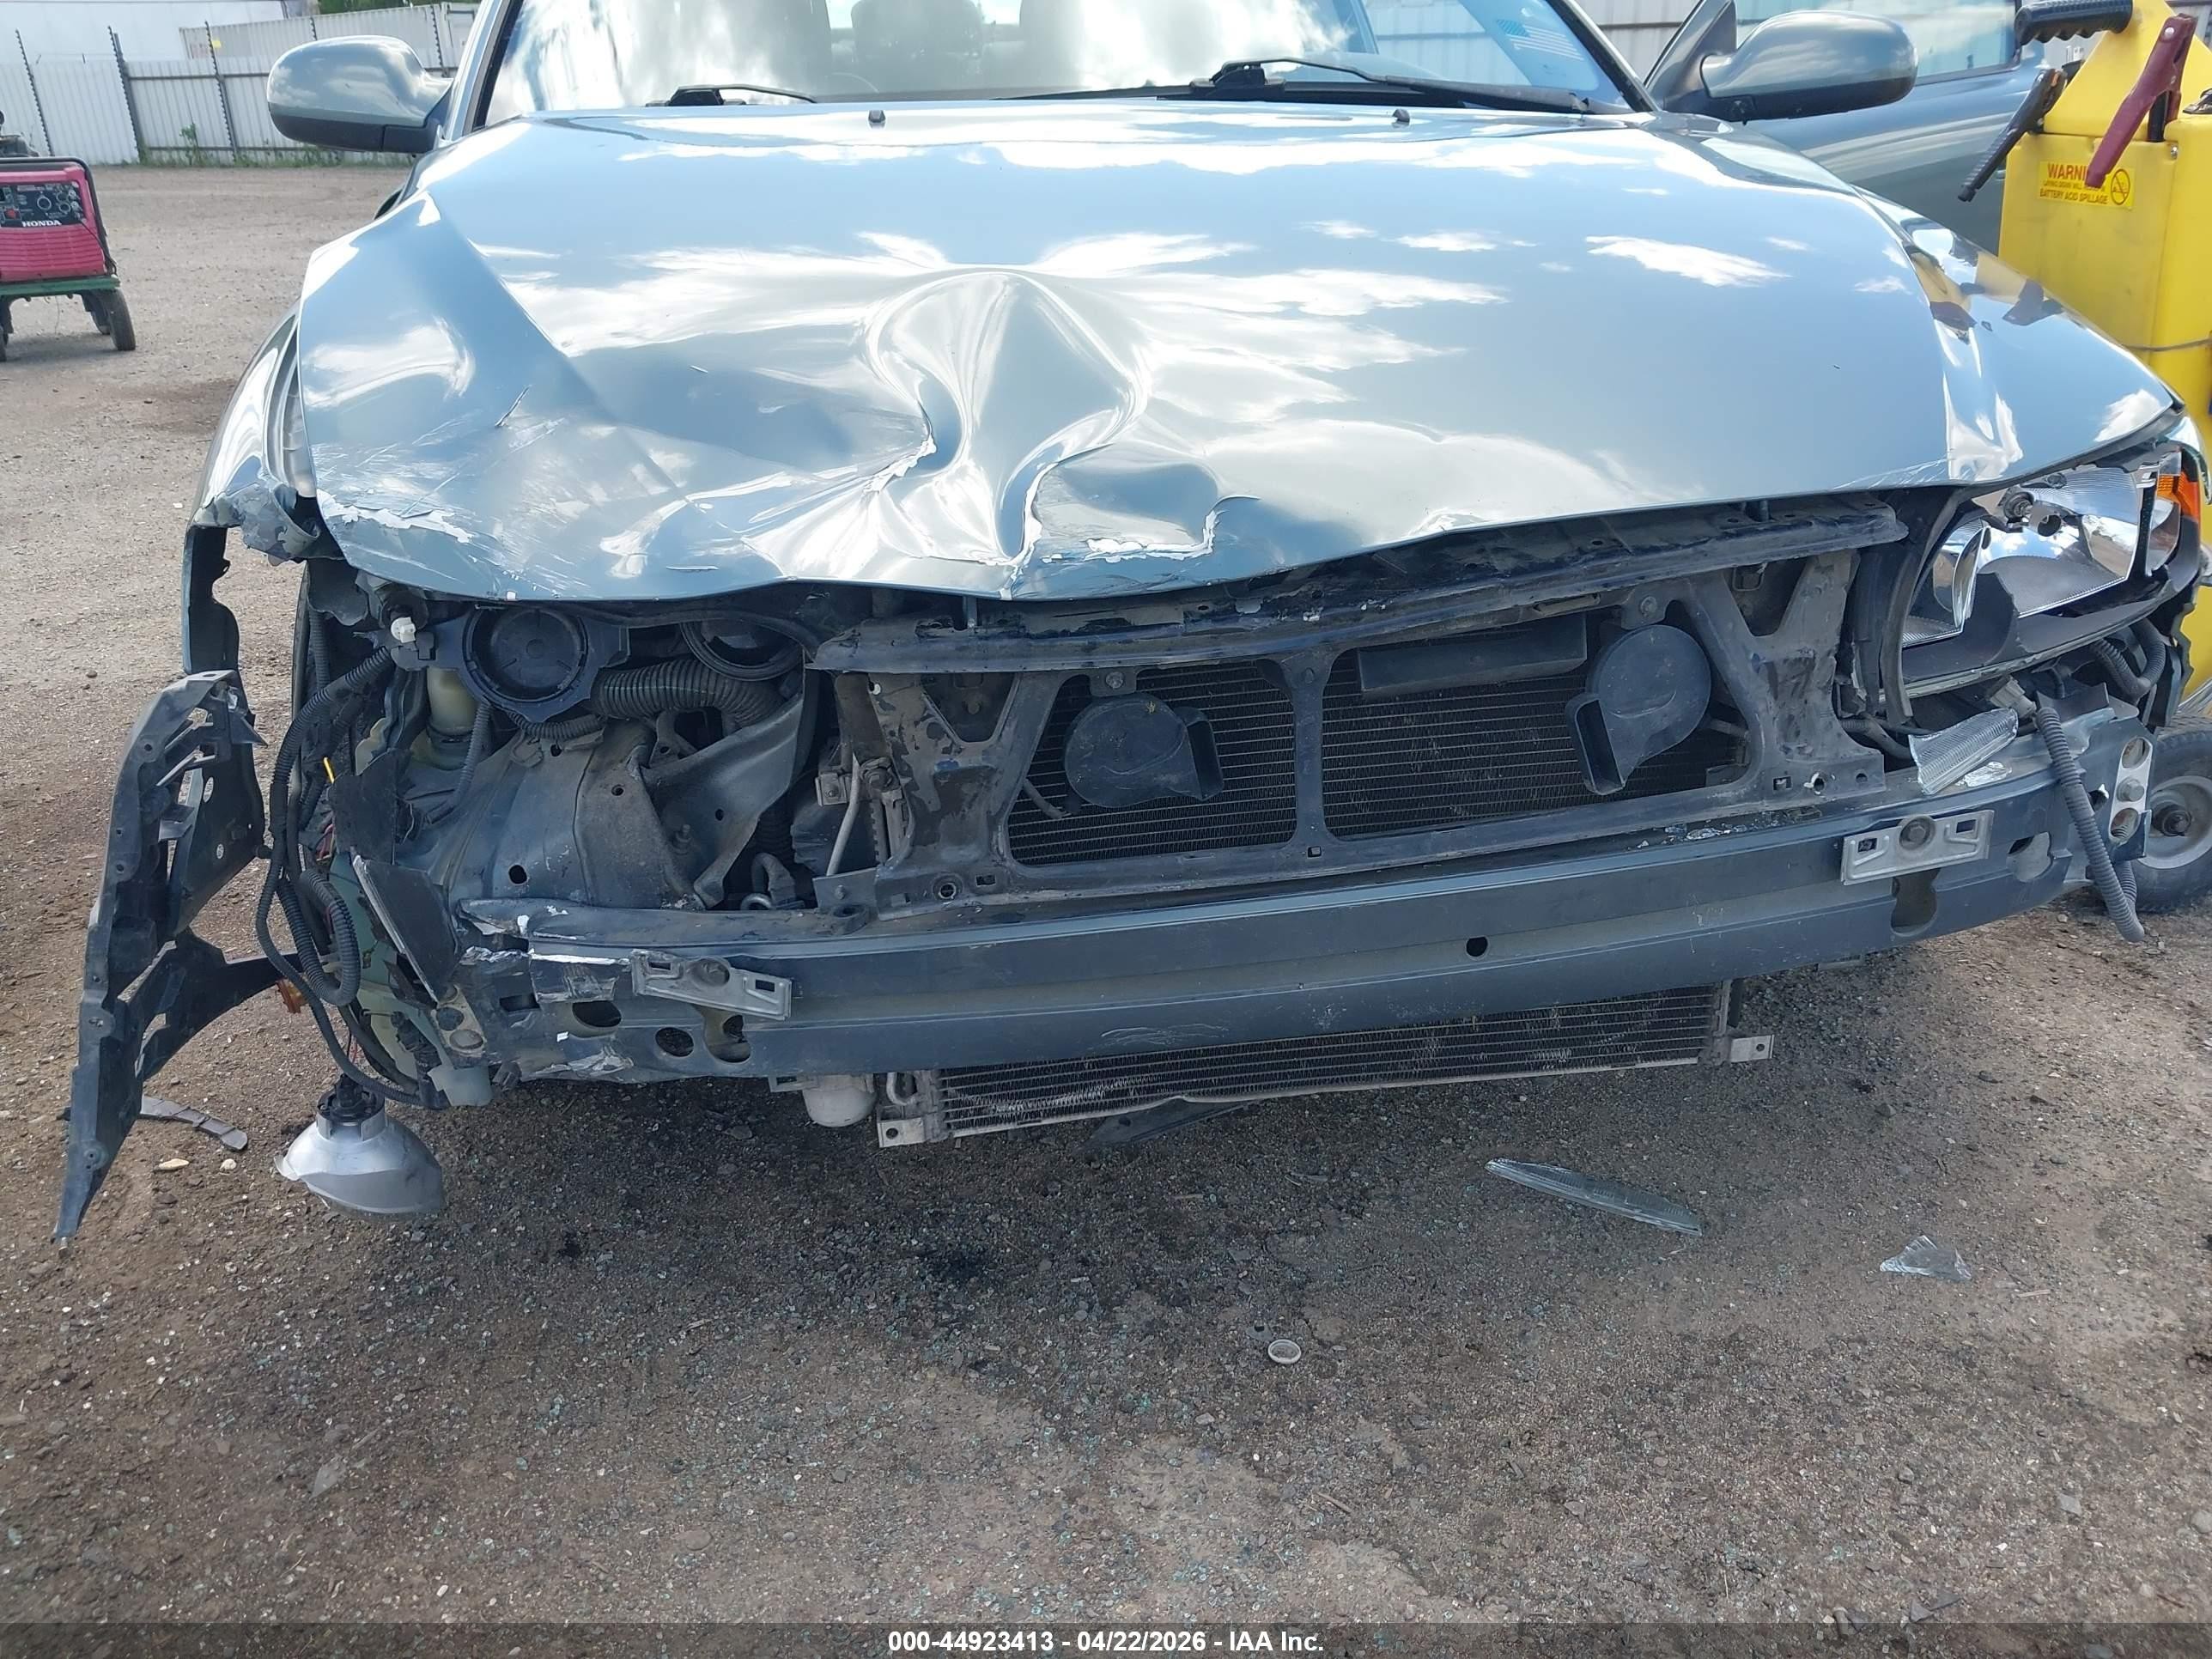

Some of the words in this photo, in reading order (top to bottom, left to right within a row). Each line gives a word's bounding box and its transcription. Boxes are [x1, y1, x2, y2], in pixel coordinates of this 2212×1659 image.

[2039, 188, 2063, 199] BATTERY
[2064, 191, 2078, 202] ACID
[2079, 192, 2108, 204] SPILLAGE
